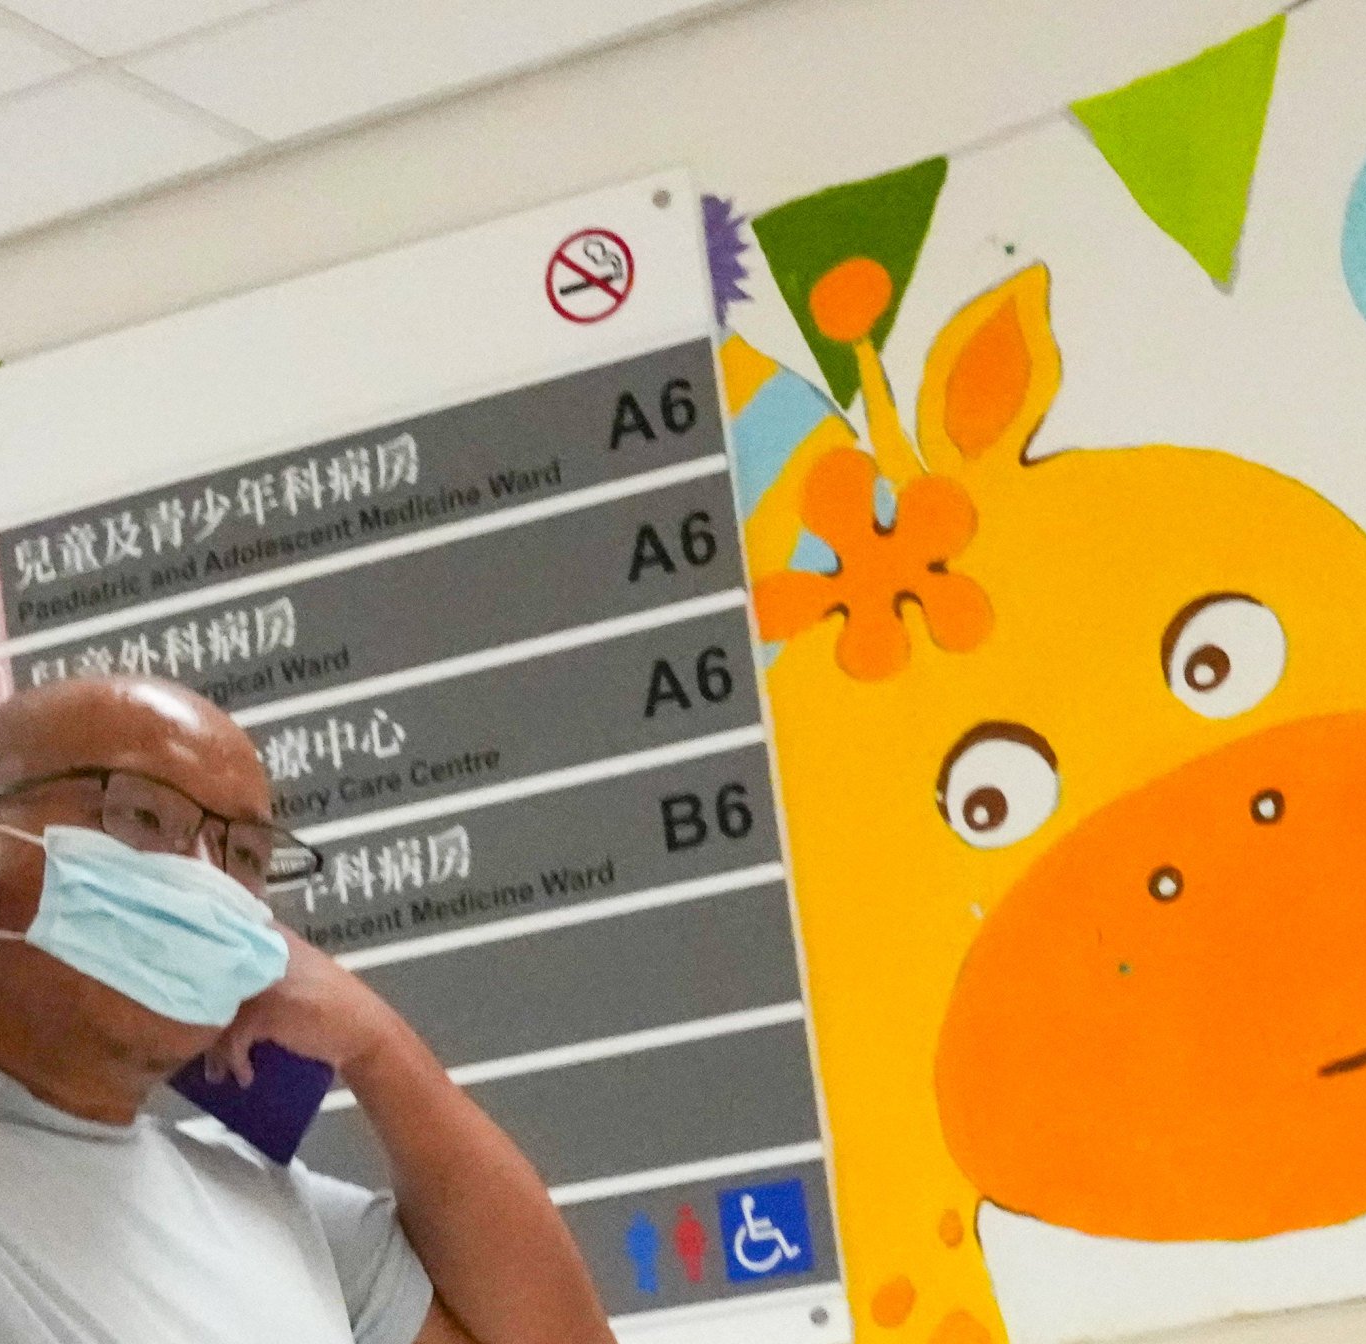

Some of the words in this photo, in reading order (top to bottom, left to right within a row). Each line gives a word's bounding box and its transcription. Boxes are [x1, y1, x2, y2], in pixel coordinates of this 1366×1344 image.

[609, 378, 698, 450] A6
[14, 431, 419, 592] 兒童及青少年科病房
[18, 572, 140, 623] Paediatric
[152, 555, 197, 589] and
[204, 516, 352, 577] Adolescent
[358, 483, 481, 533] Medicine
[488, 458, 563, 501] Ward
[627, 510, 717, 583] A6
[280, 643, 349, 684] Ward
[644, 646, 733, 718] A6
[256, 708, 406, 782] 療中心
[271, 787, 332, 818] tory
[339, 772, 403, 800] Care
[409, 750, 501, 788] Centre
[661, 781, 753, 852] B6
[305, 906, 403, 946] lescent
[410, 880, 535, 926] Medicine
[540, 856, 616, 898] Ward
